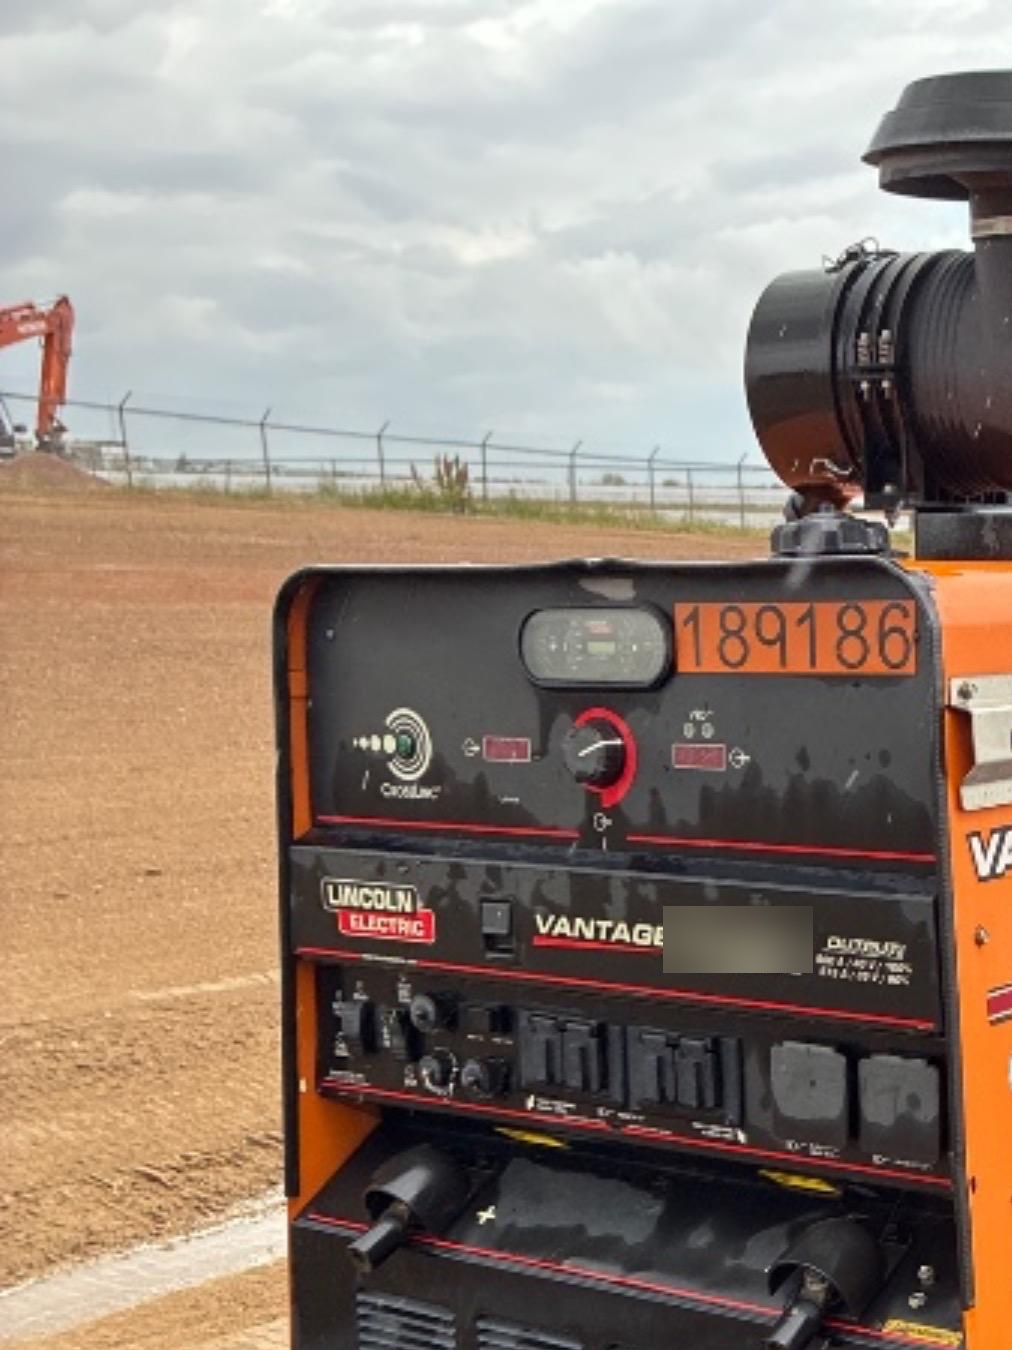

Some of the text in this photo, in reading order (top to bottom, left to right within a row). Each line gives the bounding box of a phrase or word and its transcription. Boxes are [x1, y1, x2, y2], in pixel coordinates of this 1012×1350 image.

[682, 603, 911, 669] 189186
[327, 884, 412, 913] LINCOLN
[350, 914, 425, 937] ELECTRIC
